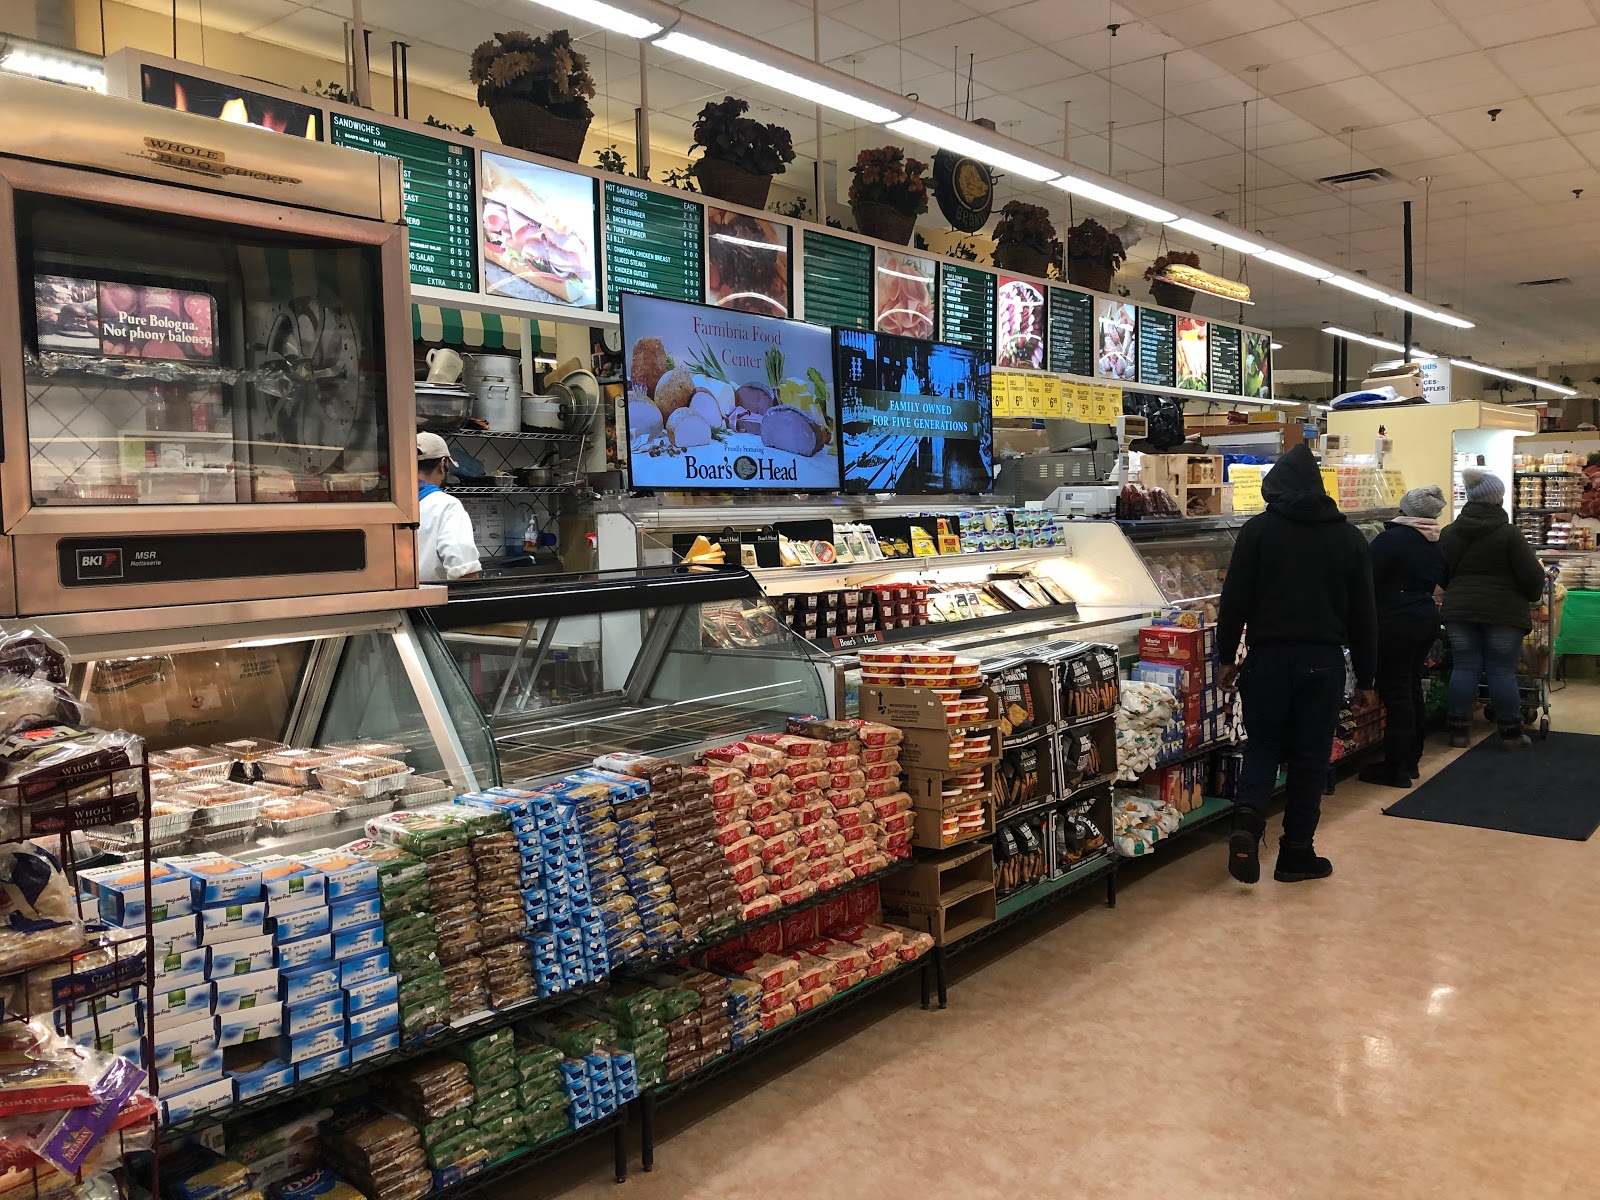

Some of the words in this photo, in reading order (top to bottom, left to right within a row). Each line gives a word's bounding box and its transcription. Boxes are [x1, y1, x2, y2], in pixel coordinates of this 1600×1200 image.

[333, 116, 381, 136] SANDWICHES
[151, 139, 218, 160] WHOLE
[373, 139, 387, 149] HAM
[606, 183, 615, 191] HOT
[616, 186, 648, 200] SANDWICHES
[683, 202, 697, 211] EACH
[613, 196, 638, 207] HAMBURGER
[613, 205, 646, 219] CHEESEBURGER
[613, 215, 627, 225] BACON
[627, 218, 644, 229] BURGER
[613, 226, 629, 236] TURKEY
[630, 229, 647, 239] BURGER
[416, 253, 435, 262] SALAD
[613, 246, 635, 256] CHARCOAL
[636, 250, 654, 260] CHICKEN
[654, 254, 671, 263] BREAST
[613, 256, 629, 265] SLICED
[630, 259, 647, 268] STEAKS
[615, 266, 633, 276] CHICKEN
[633, 269, 649, 278] CUTLET
[428, 278, 446, 286] EXTRA
[615, 276, 633, 286] CHICKEN
[119, 311, 147, 326] Pure
[150, 314, 198, 332] Bologna.
[103, 323, 127, 337] Not
[129, 327, 166, 343] phony
[693, 316, 748, 341] Farmbria
[753, 325, 781, 346] Food
[722, 349, 761, 369] Center
[889, 400, 920, 413] FAMILY
[922, 402, 952, 415] OWNED
[872, 415, 890, 427] FOR
[892, 416, 911, 428] FIVE
[913, 418, 968, 432] GENERATIONS
[724, 444, 742, 453] Proudly
[685, 456, 732, 480] Boar's
[758, 458, 798, 481] Head
[82, 556, 102, 567] BKI
[135, 552, 157, 560] MSR
[839, 636, 857, 647] Boar's
[863, 634, 878, 644] Head
[62, 757, 101, 776] WHOLE
